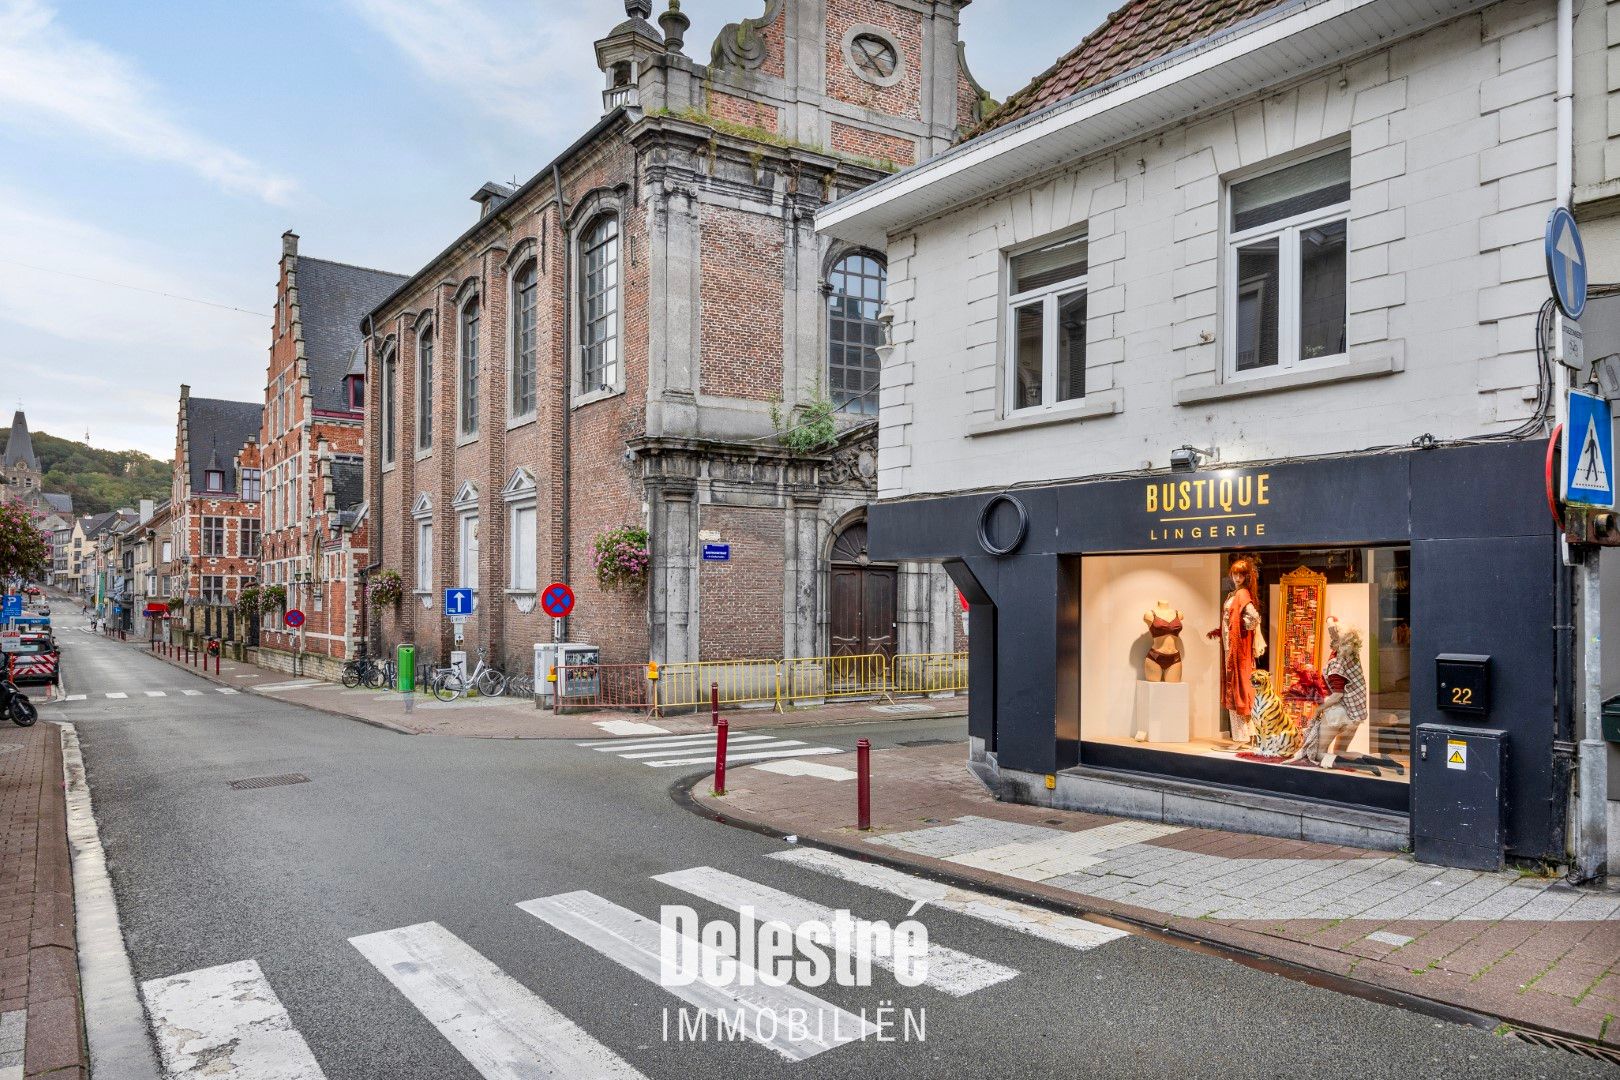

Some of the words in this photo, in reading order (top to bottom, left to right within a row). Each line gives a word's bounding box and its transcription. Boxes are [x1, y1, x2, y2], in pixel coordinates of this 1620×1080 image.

[1146, 474, 1270, 512] BUSTIQUE
[1151, 524, 1265, 540] LINGERIE
[1452, 687, 1472, 704] 22
